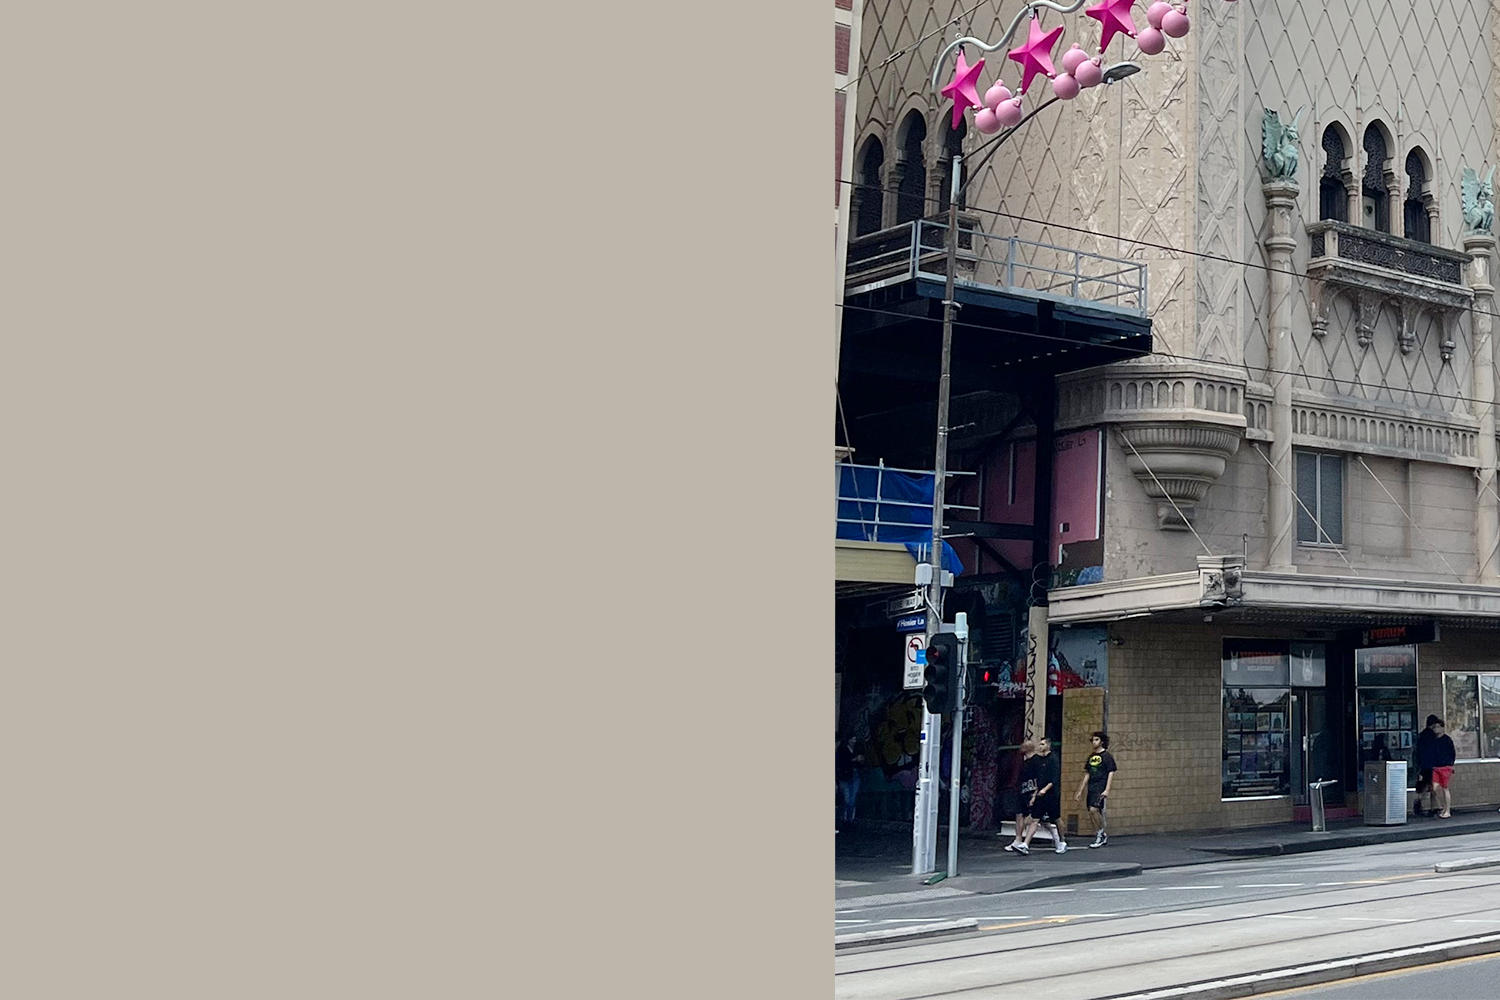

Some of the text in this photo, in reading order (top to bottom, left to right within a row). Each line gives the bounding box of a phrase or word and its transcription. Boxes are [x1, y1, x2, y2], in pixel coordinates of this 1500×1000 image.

[900, 619, 917, 627] Hosier
[1370, 626, 1407, 640] FORUM
[1239, 651, 1282, 665] FORUM
[1371, 653, 1411, 667] FORUM
